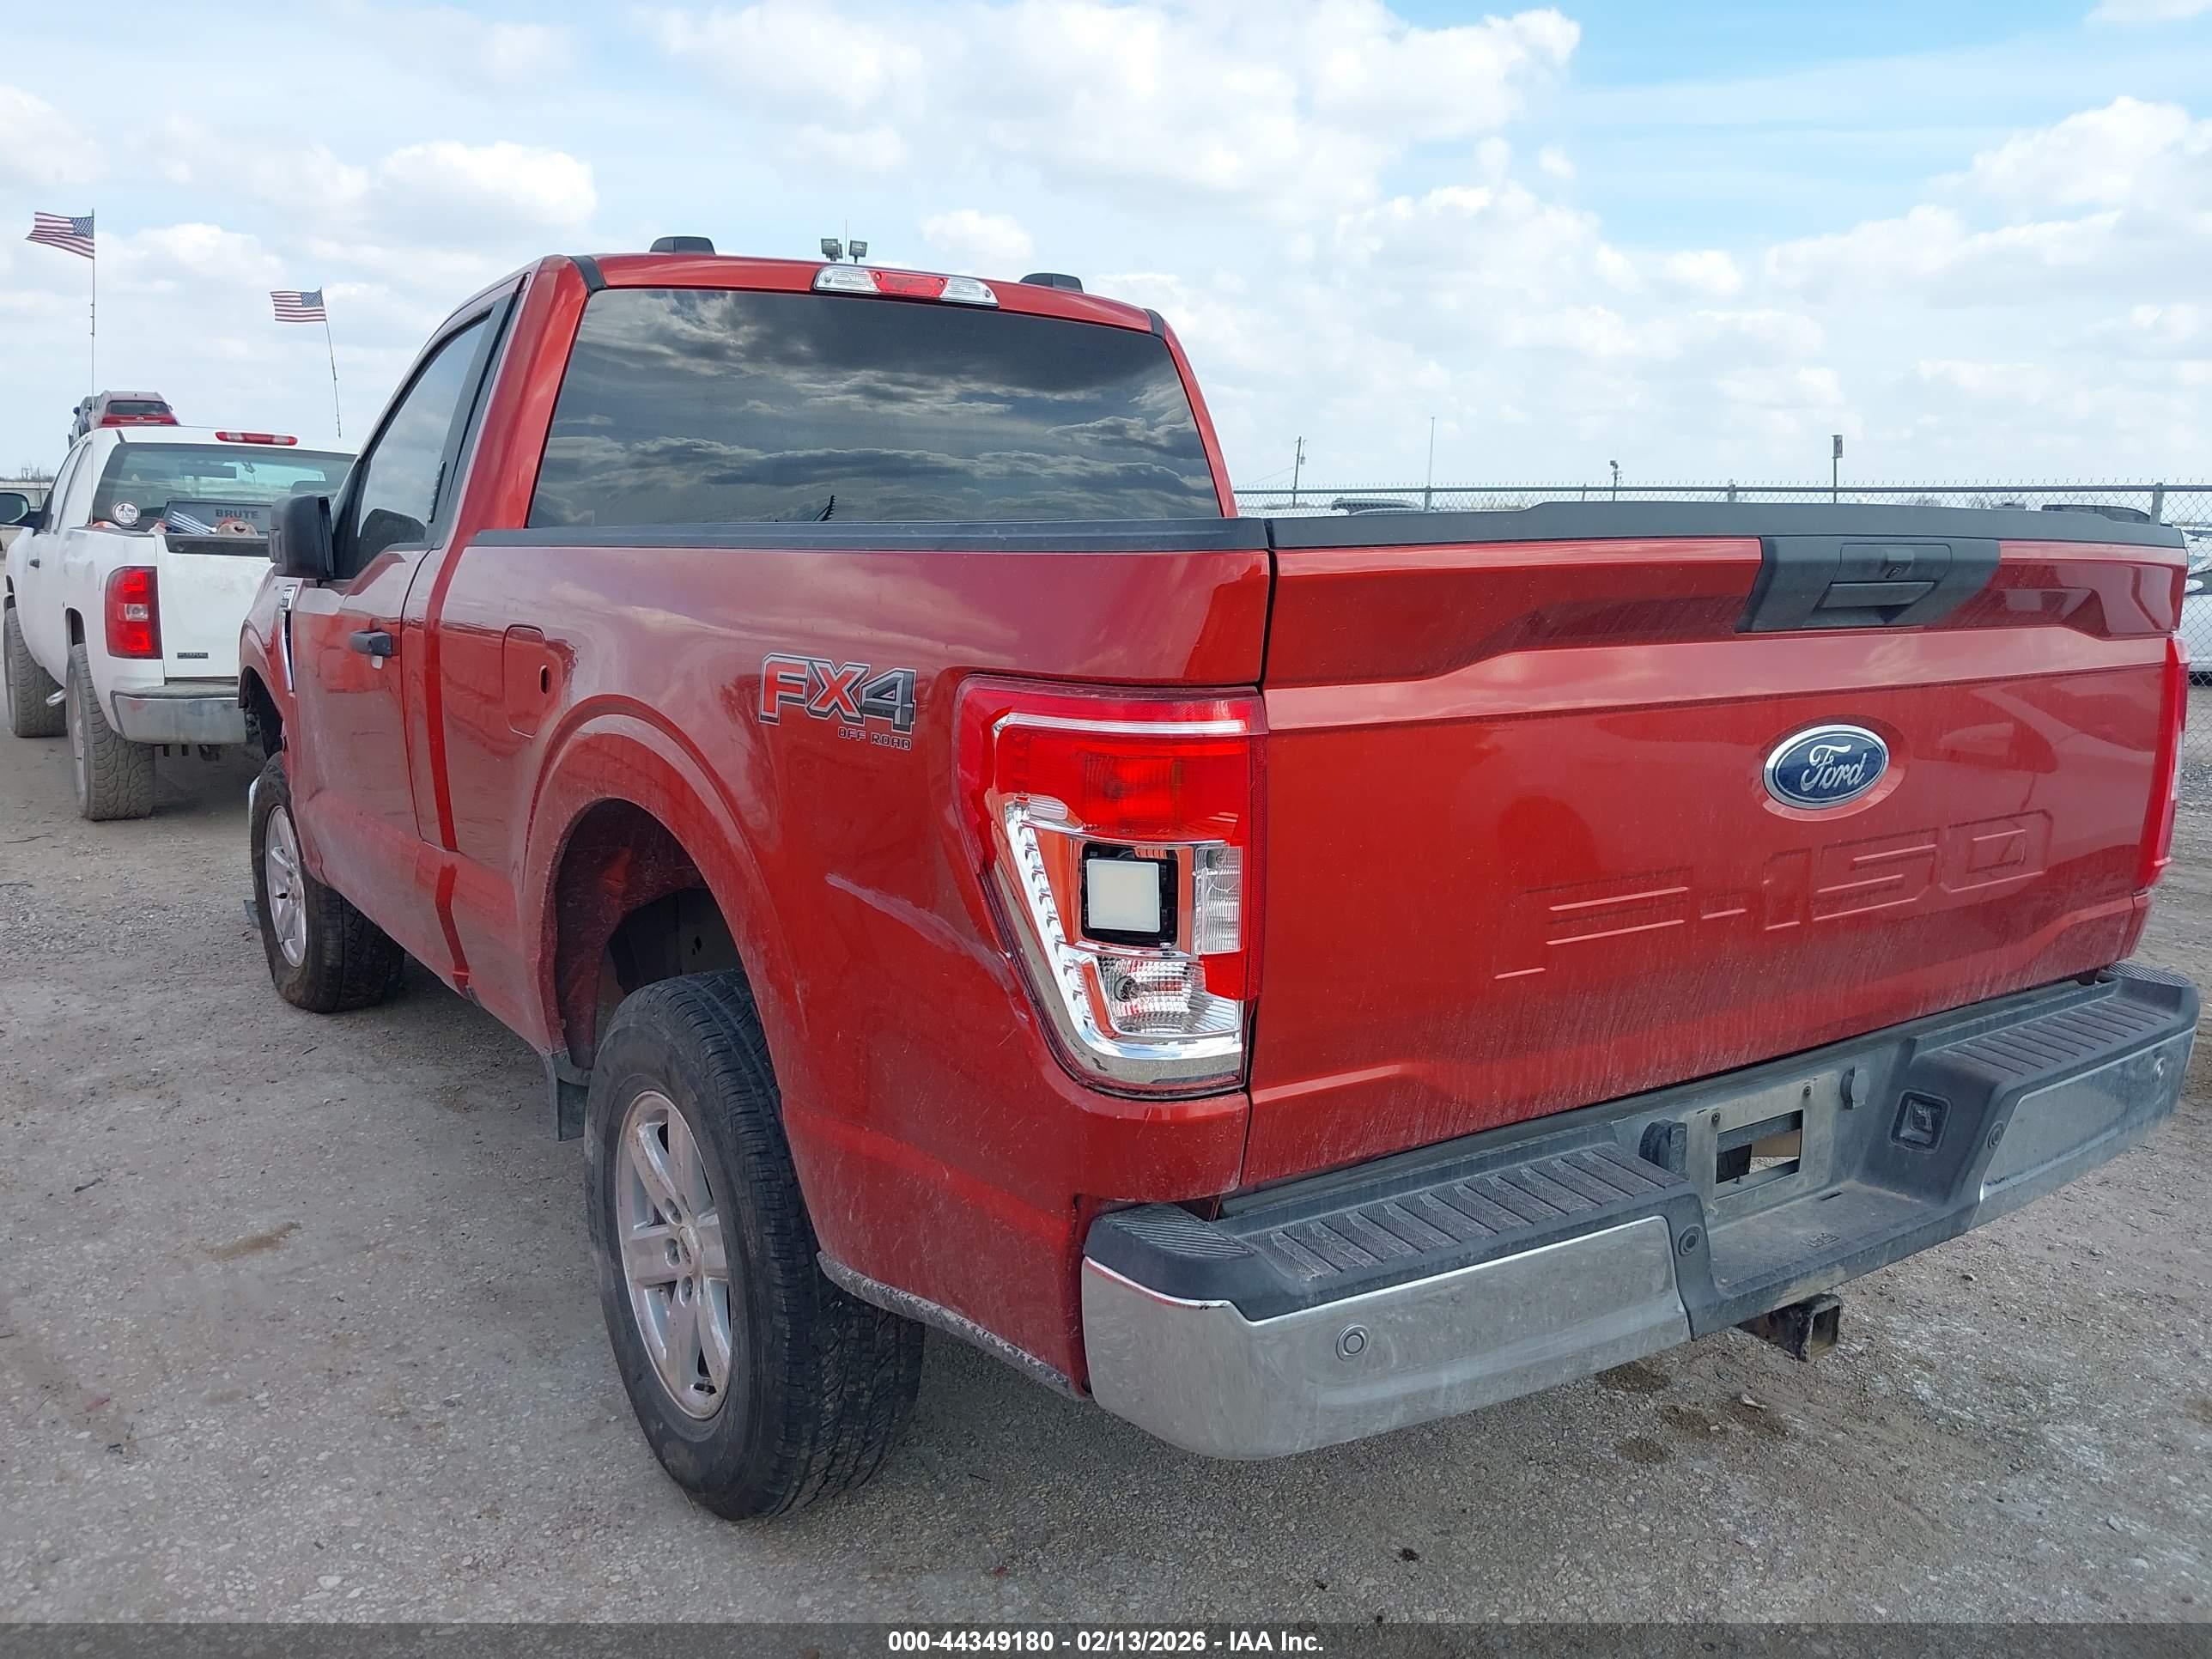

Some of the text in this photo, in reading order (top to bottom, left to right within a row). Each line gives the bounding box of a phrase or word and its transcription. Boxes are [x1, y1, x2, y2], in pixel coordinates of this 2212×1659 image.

[215, 508, 259, 520] BRUTE
[759, 653, 917, 734] FX4
[837, 726, 912, 750] OFF ROAD
[1800, 744, 1868, 792] Ford
[1492, 807, 2055, 981] F-150
